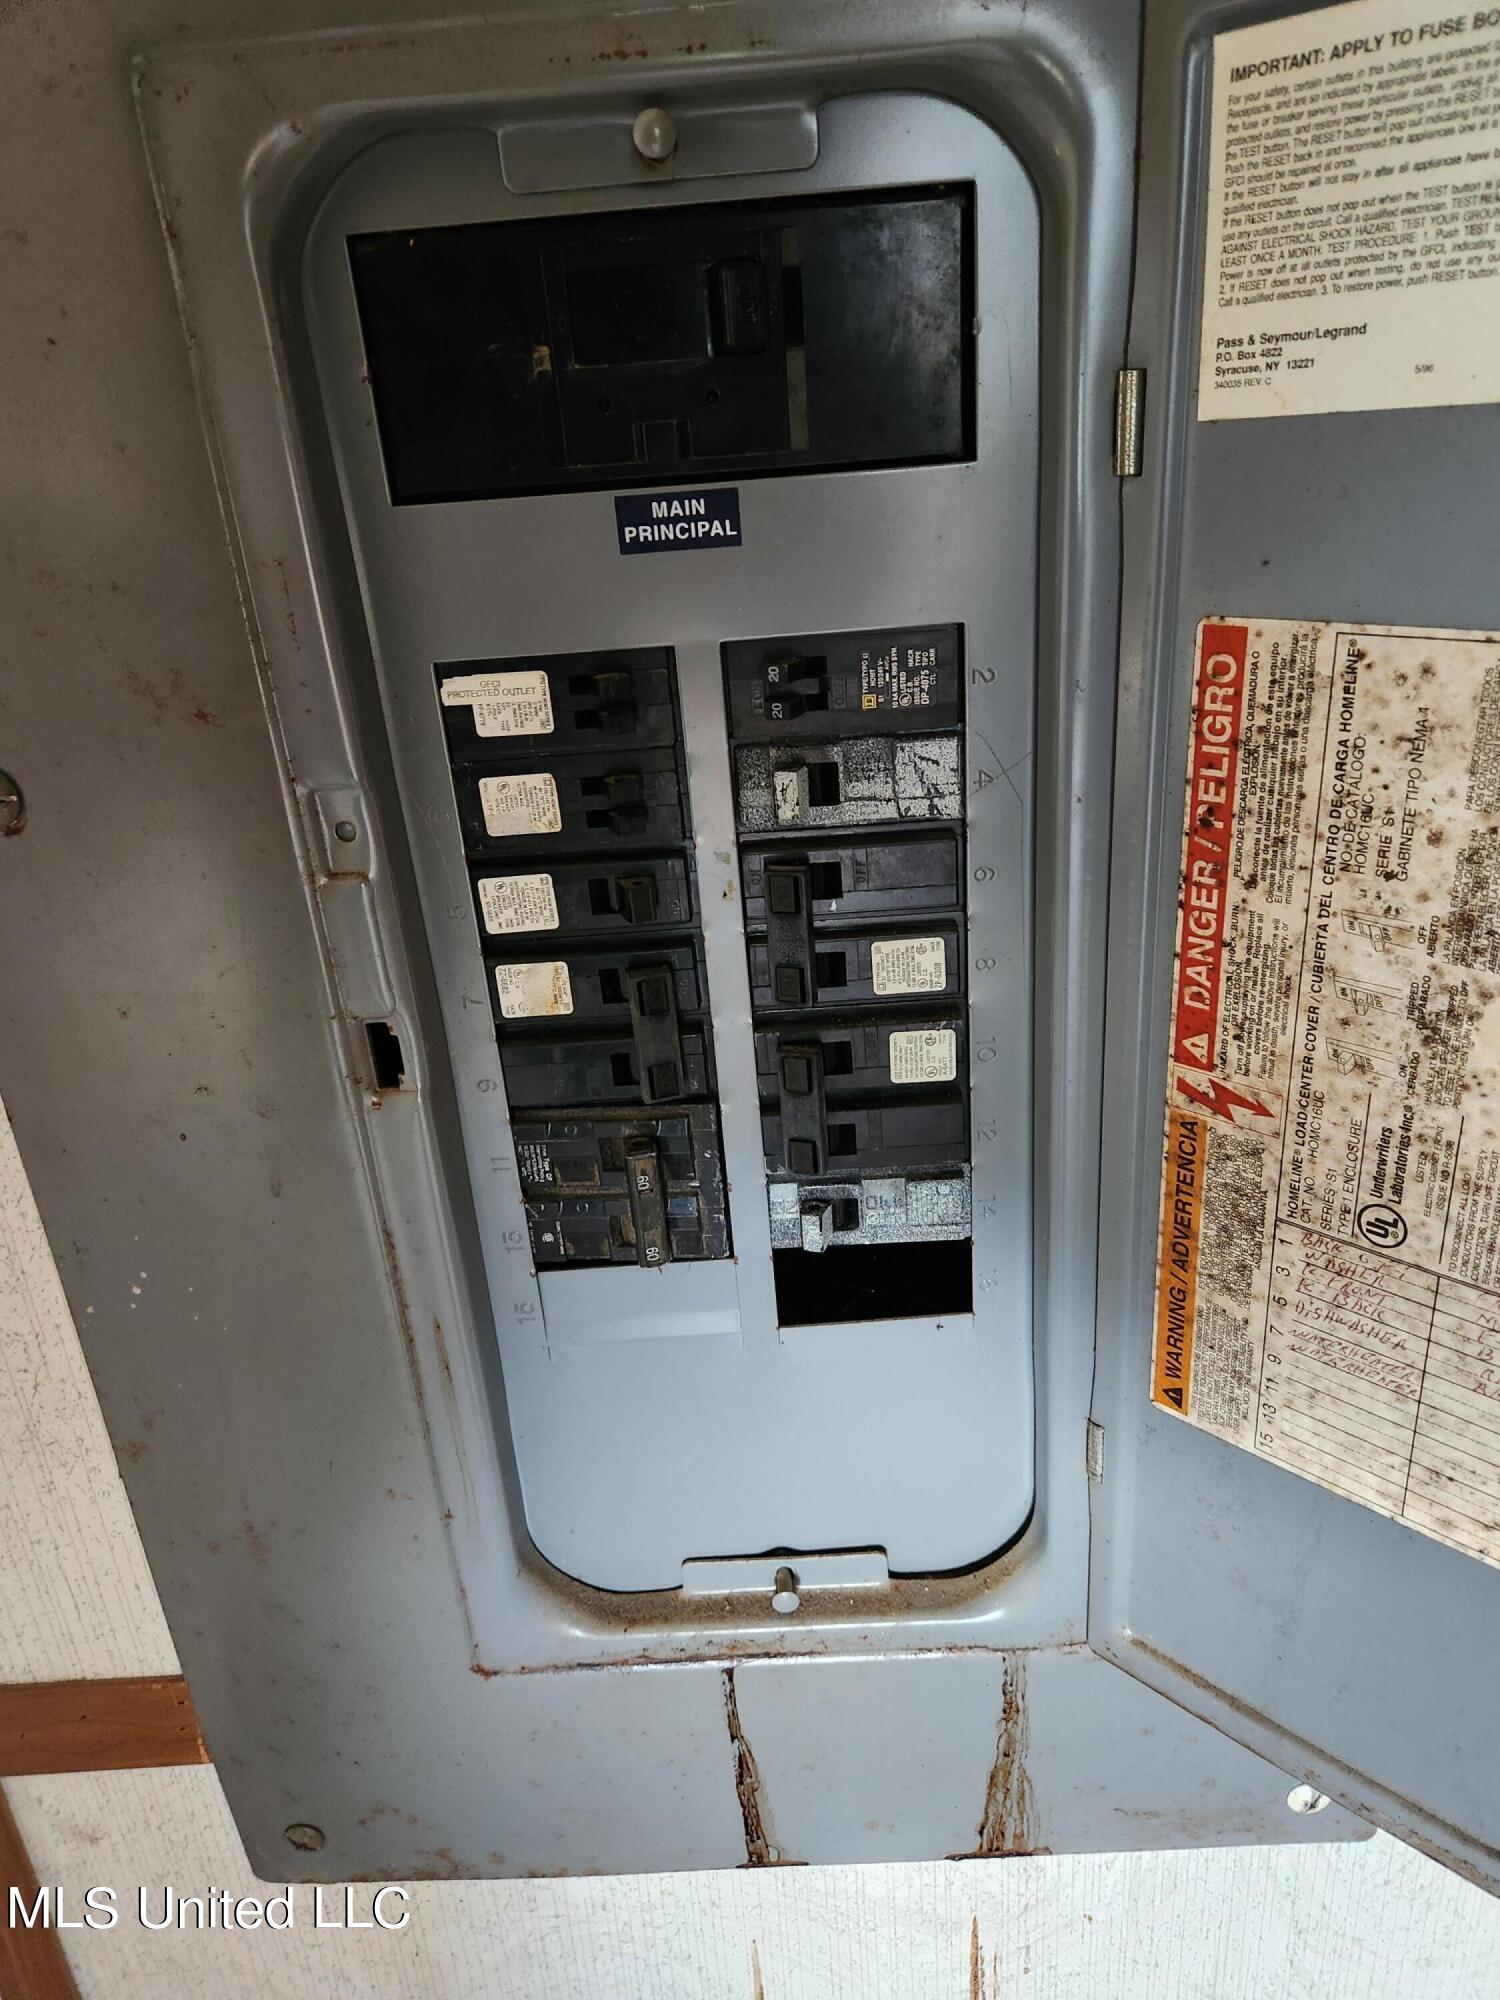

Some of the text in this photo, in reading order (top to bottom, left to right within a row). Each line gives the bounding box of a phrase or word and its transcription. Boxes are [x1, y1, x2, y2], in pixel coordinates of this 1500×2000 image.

[1230, 47, 1324, 83] IMPORTANT:
[1330, 33, 1384, 61] APPLY
[1391, 28, 1413, 47] TO
[1419, 15, 1467, 41] FUSE
[1216, 322, 1368, 349] Pass & Seymour/Legrand
[1214, 358, 1315, 377] Syracuse, NY 13221
[1215, 347, 1283, 363] P.O. Box 4822
[651, 498, 705, 518] MAIN
[624, 519, 738, 543] PRINCIPAL
[1252, 651, 1260, 659] O
[1270, 642, 1280, 677] equipo
[479, 680, 501, 689] GFCI
[768, 666, 779, 682] 20
[921, 670, 929, 704] DP-4075
[972, 668, 997, 685] 2
[447, 686, 537, 699] PROTECTED OUTLET
[772, 703, 782, 718] 20
[1332, 739, 1349, 794] CARGA
[1405, 767, 1420, 802] TIPO
[1329, 799, 1343, 819] DE
[1185, 653, 1237, 1009] DANGER PELIGRO
[1395, 807, 1416, 881] GABINETE
[1321, 825, 1340, 885] CENTRO
[1375, 835, 1392, 877] SERIE
[1318, 891, 1332, 919] DEL
[1253, 926, 1262, 959] Replace
[1418, 924, 1428, 944] OFF
[1427, 915, 1440, 958] ABIERTO
[1310, 923, 1329, 993] CUBIERTA
[1235, 1058, 1243, 1074] Turn
[1246, 910, 1255, 955] equipment
[1255, 1001, 1264, 1026] before
[1222, 1025, 1229, 1036] OF
[1304, 1005, 1320, 1052] COVER
[1298, 1055, 1314, 1108] CENTER
[1398, 1064, 1408, 1078] ON
[1294, 1112, 1308, 1146] LOAD
[1308, 1090, 1325, 1159] HOMC16UC
[1342, 1118, 1362, 1194] ENCLOSURE
[1370, 1127, 1393, 1198] Underwriters
[1388, 1134, 1412, 1205] Laboratories
[636, 1175, 650, 1191] 60
[1172, 1119, 1199, 1273] ADVERTENCIA
[1320, 1168, 1337, 1230] SERIES S1
[1338, 1204, 1351, 1236] TYPE
[645, 1247, 660, 1262] 60
[1278, 1238, 1293, 1246] 1
[1276, 1266, 1291, 1277] 3
[1273, 1295, 1288, 1306] 5
[1164, 1285, 1187, 1380] WARNING
[1270, 1324, 1284, 1336] 7
[1267, 1353, 1282, 1365] 9
[1265, 1377, 1280, 1393] 11
[1262, 1403, 1277, 1421] 13
[1259, 1432, 1273, 1450] 15
